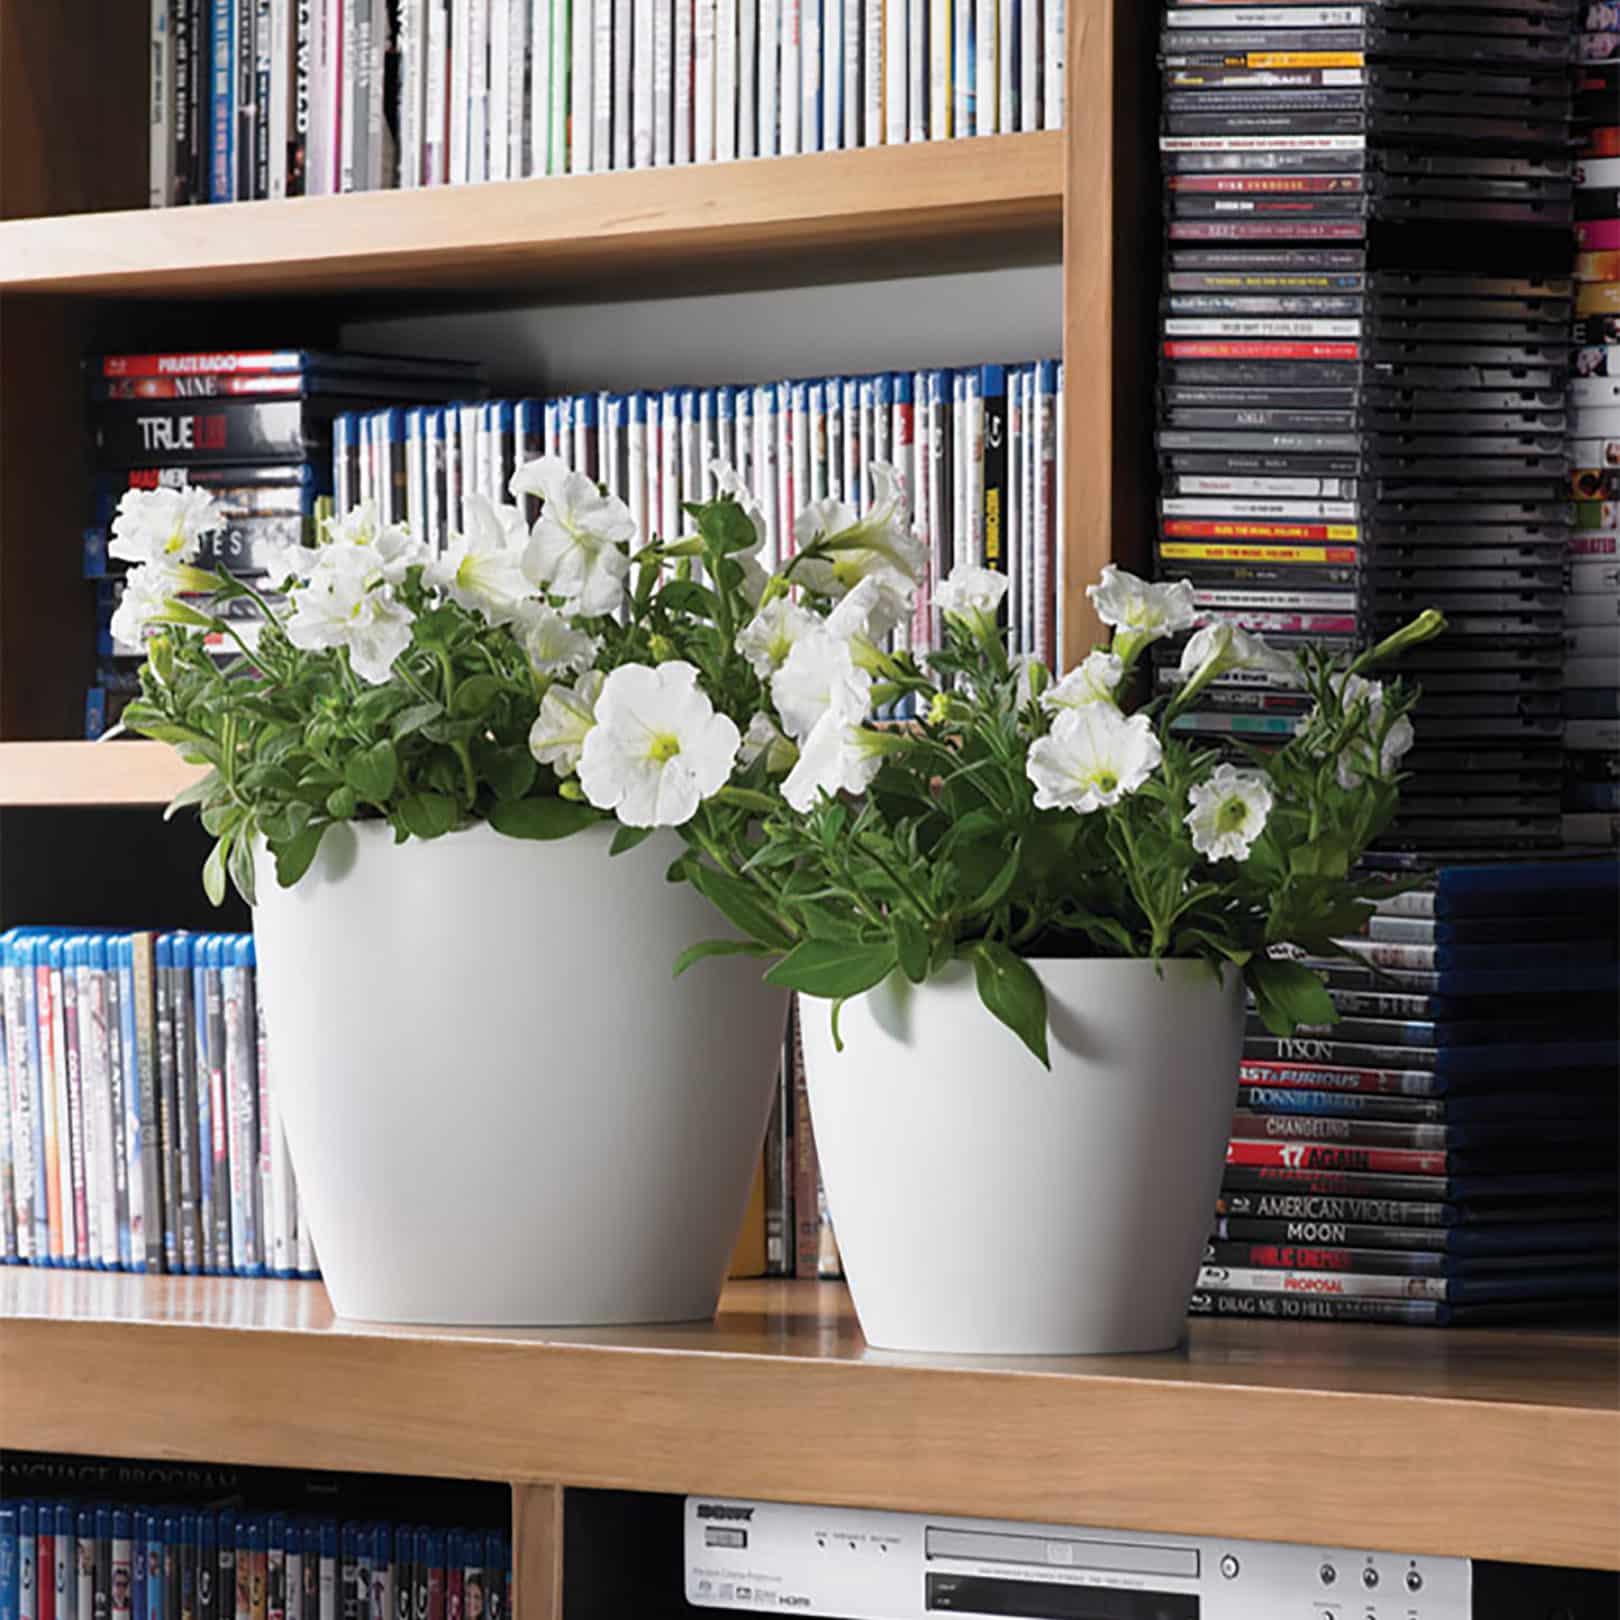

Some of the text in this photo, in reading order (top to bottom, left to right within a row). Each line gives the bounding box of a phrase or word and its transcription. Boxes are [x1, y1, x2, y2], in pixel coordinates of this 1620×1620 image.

[175, 376, 216, 396] NINE
[137, 416, 194, 450] TRUE
[1276, 1039, 1335, 1060] TYSON
[1279, 1143, 1305, 1168] 17
[1257, 1197, 1344, 1218] AMERICAN
[1287, 1223, 1346, 1241] MOON
